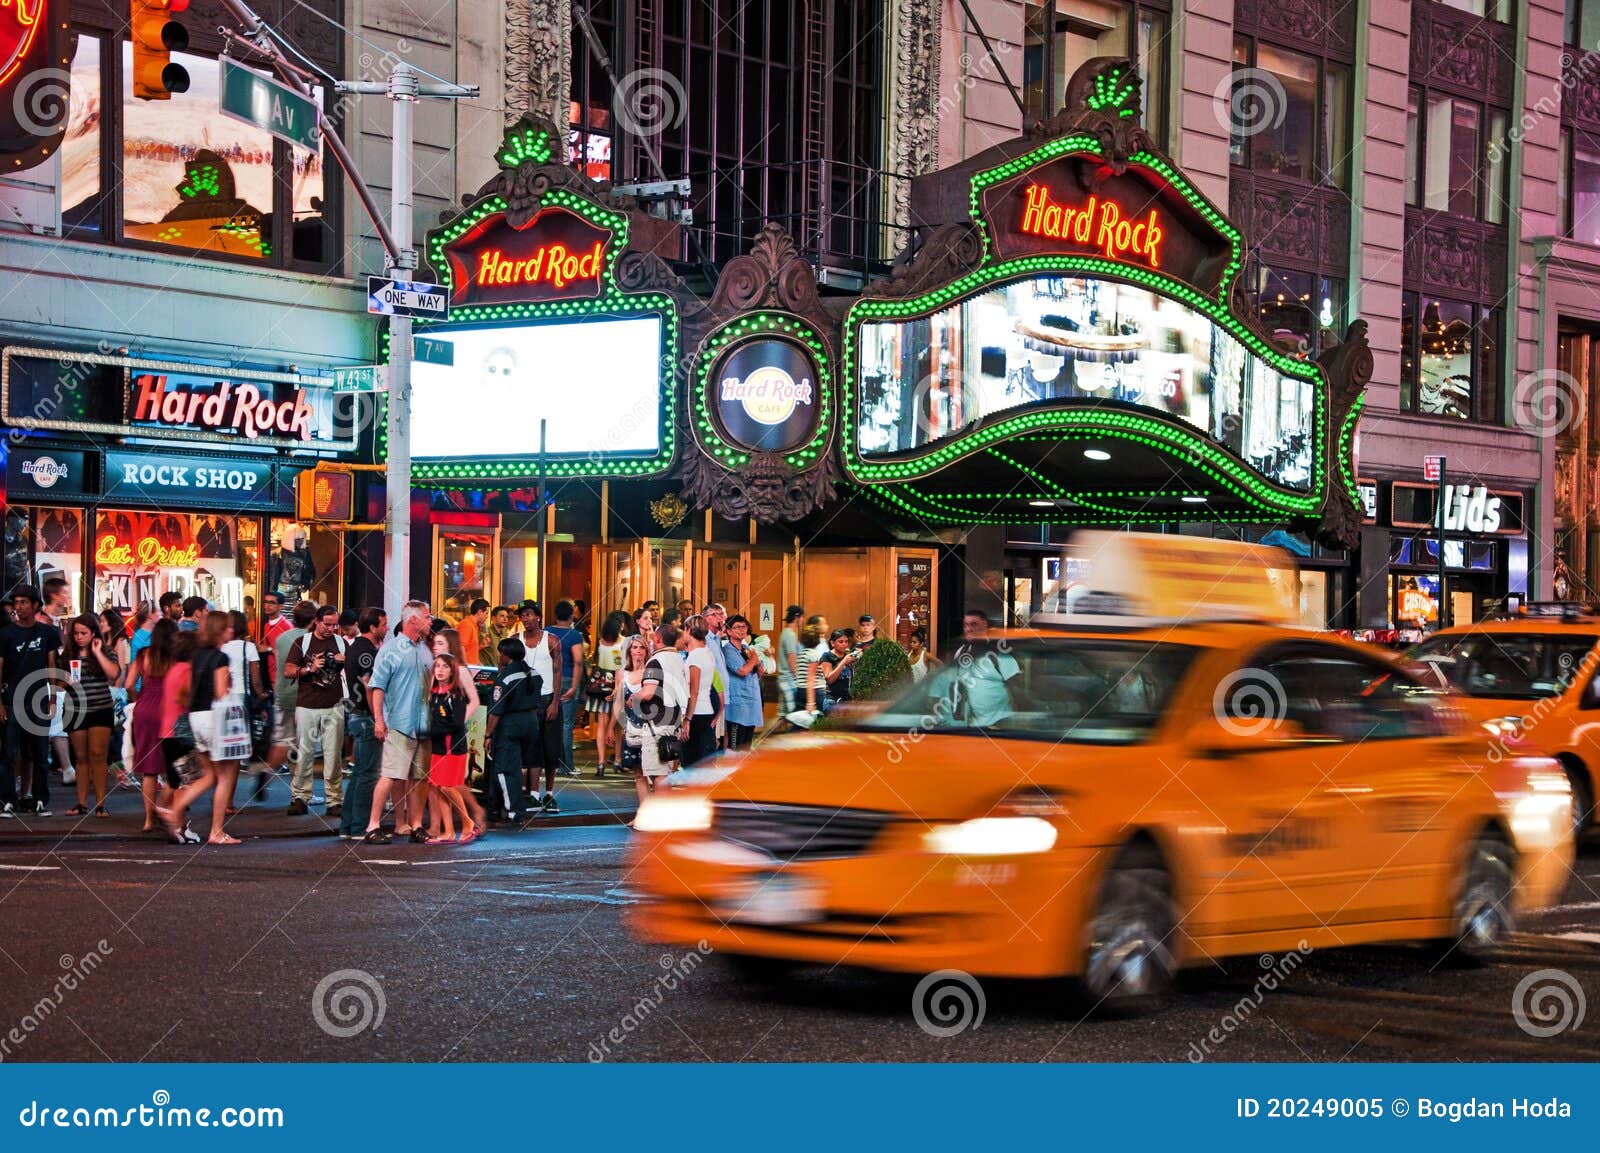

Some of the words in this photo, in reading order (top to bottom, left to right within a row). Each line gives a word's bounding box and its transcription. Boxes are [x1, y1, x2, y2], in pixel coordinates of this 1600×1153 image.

[1023, 185, 1096, 242] Hard
[1097, 202, 1162, 267] Rock
[479, 247, 545, 285] Hard
[384, 289, 407, 305] ONE
[417, 294, 441, 309] WAY
[424, 341, 433, 360] 7
[434, 343, 444, 353] AV
[346, 369, 360, 390] 43
[361, 369, 372, 380] ST
[721, 377, 769, 401] Hard
[770, 377, 812, 405] Rock
[133, 373, 231, 426] Hard
[231, 383, 315, 442] Rock
[22, 460, 46, 475] Hard
[46, 462, 69, 479] Rock
[122, 463, 190, 487] ROCK
[195, 467, 258, 490] SHOP
[1443, 484, 1501, 533] Lids
[138, 537, 200, 567] Drink
[762, 609, 770, 622] A
